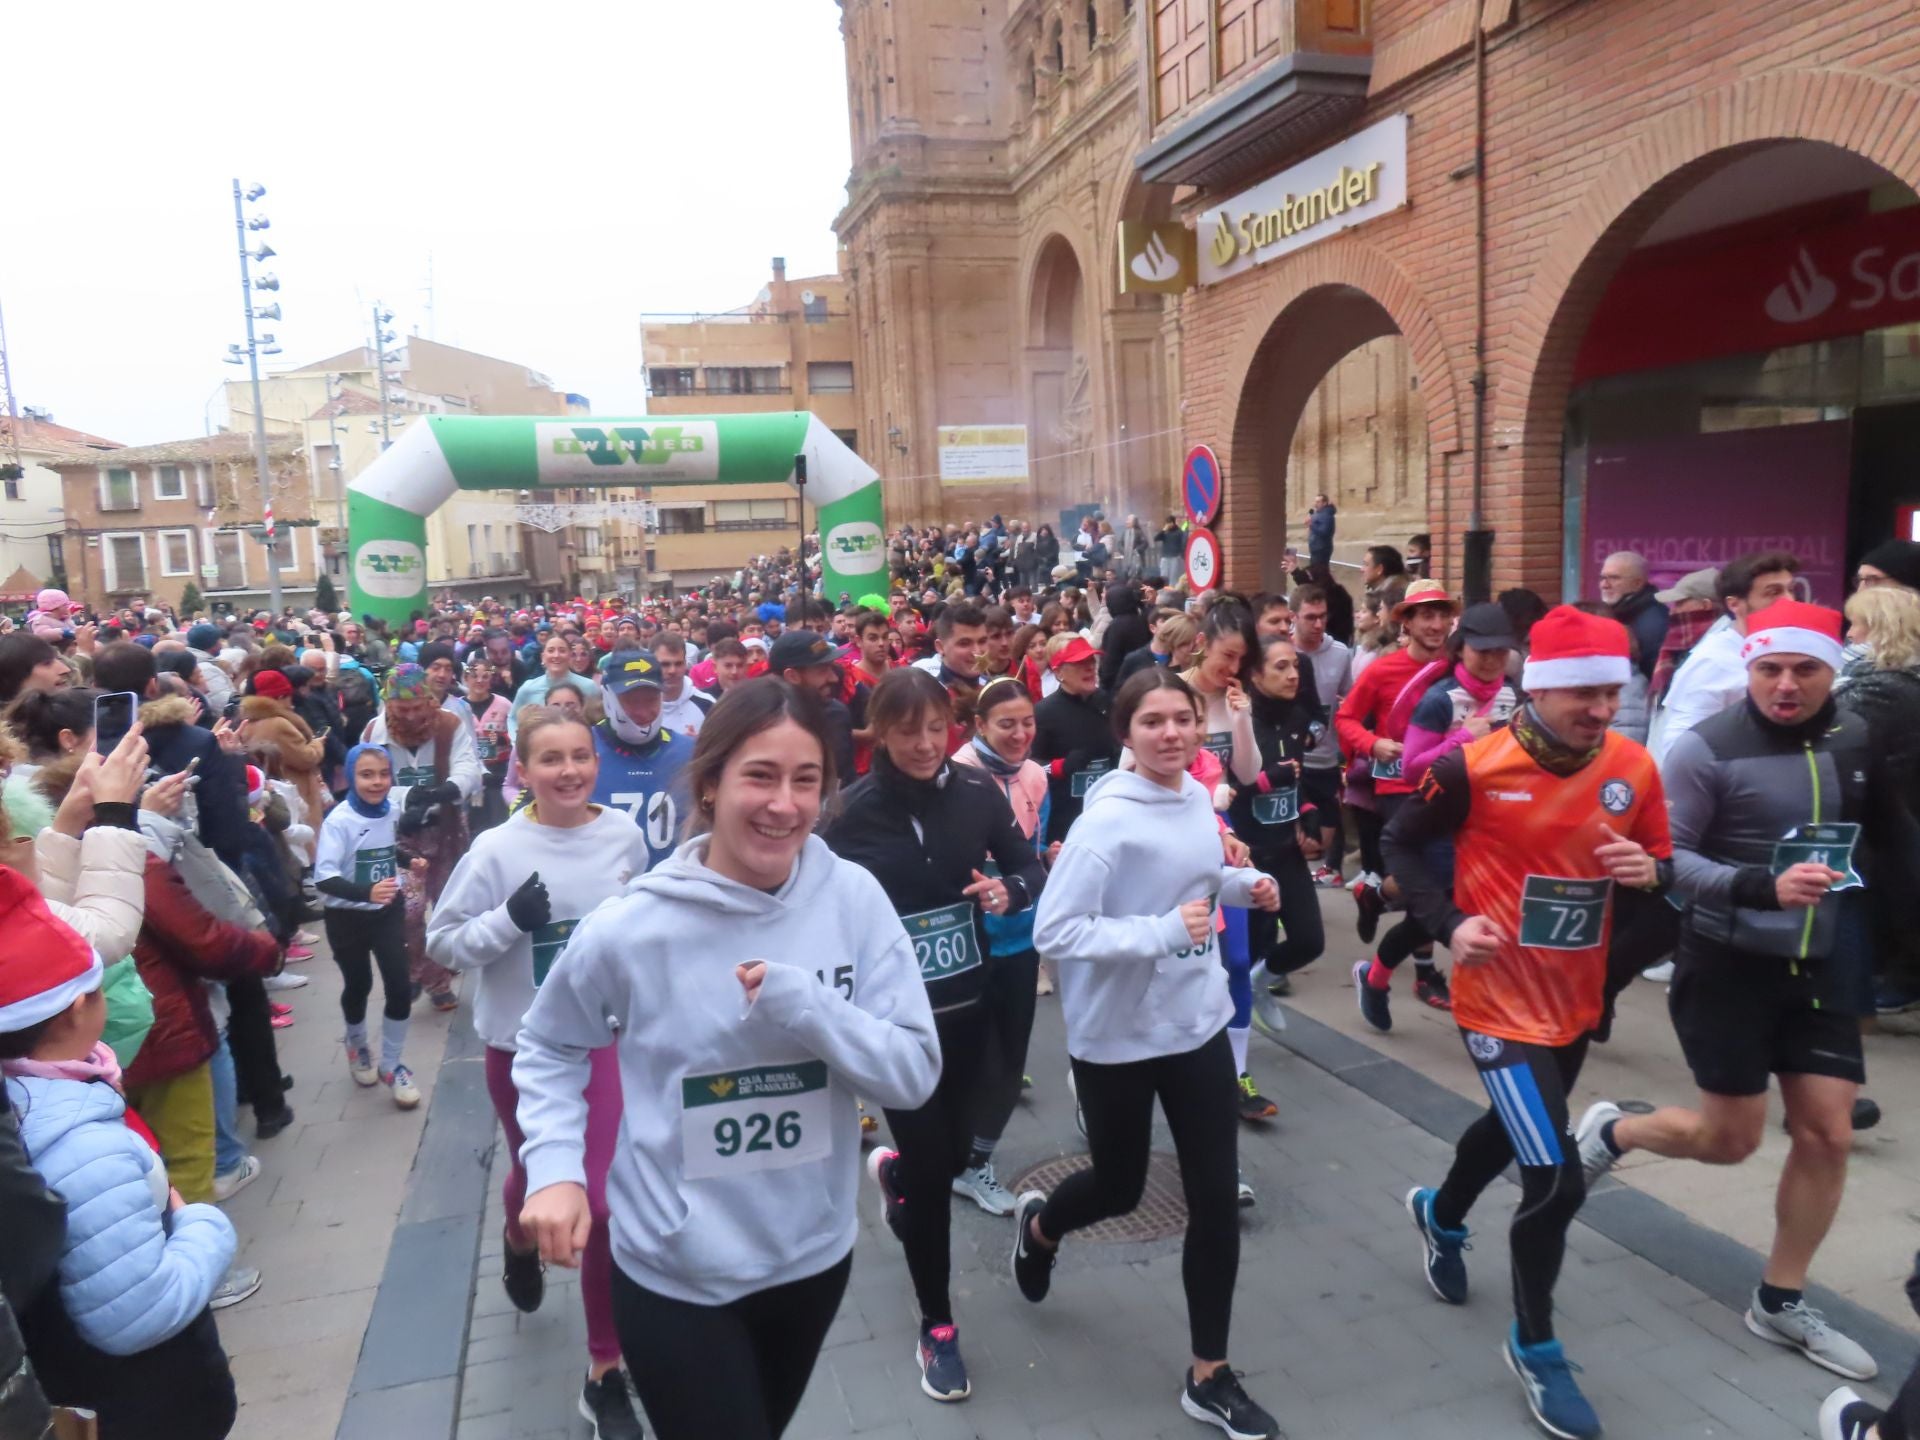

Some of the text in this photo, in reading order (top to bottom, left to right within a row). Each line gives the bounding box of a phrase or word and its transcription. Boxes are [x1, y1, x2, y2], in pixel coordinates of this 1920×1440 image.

[1238, 162, 1382, 255] Santander
[559, 438, 697, 452] TWINNER
[1594, 535, 1834, 565] EN SHOCK LITERAL
[1270, 796, 1289, 819] 78
[1549, 906, 1589, 942] 72
[915, 931, 967, 973] 260
[738, 1072, 798, 1086] CAJA RURAL
[738, 1081, 805, 1095] DE NAVARRA
[713, 1110, 802, 1157] 926
